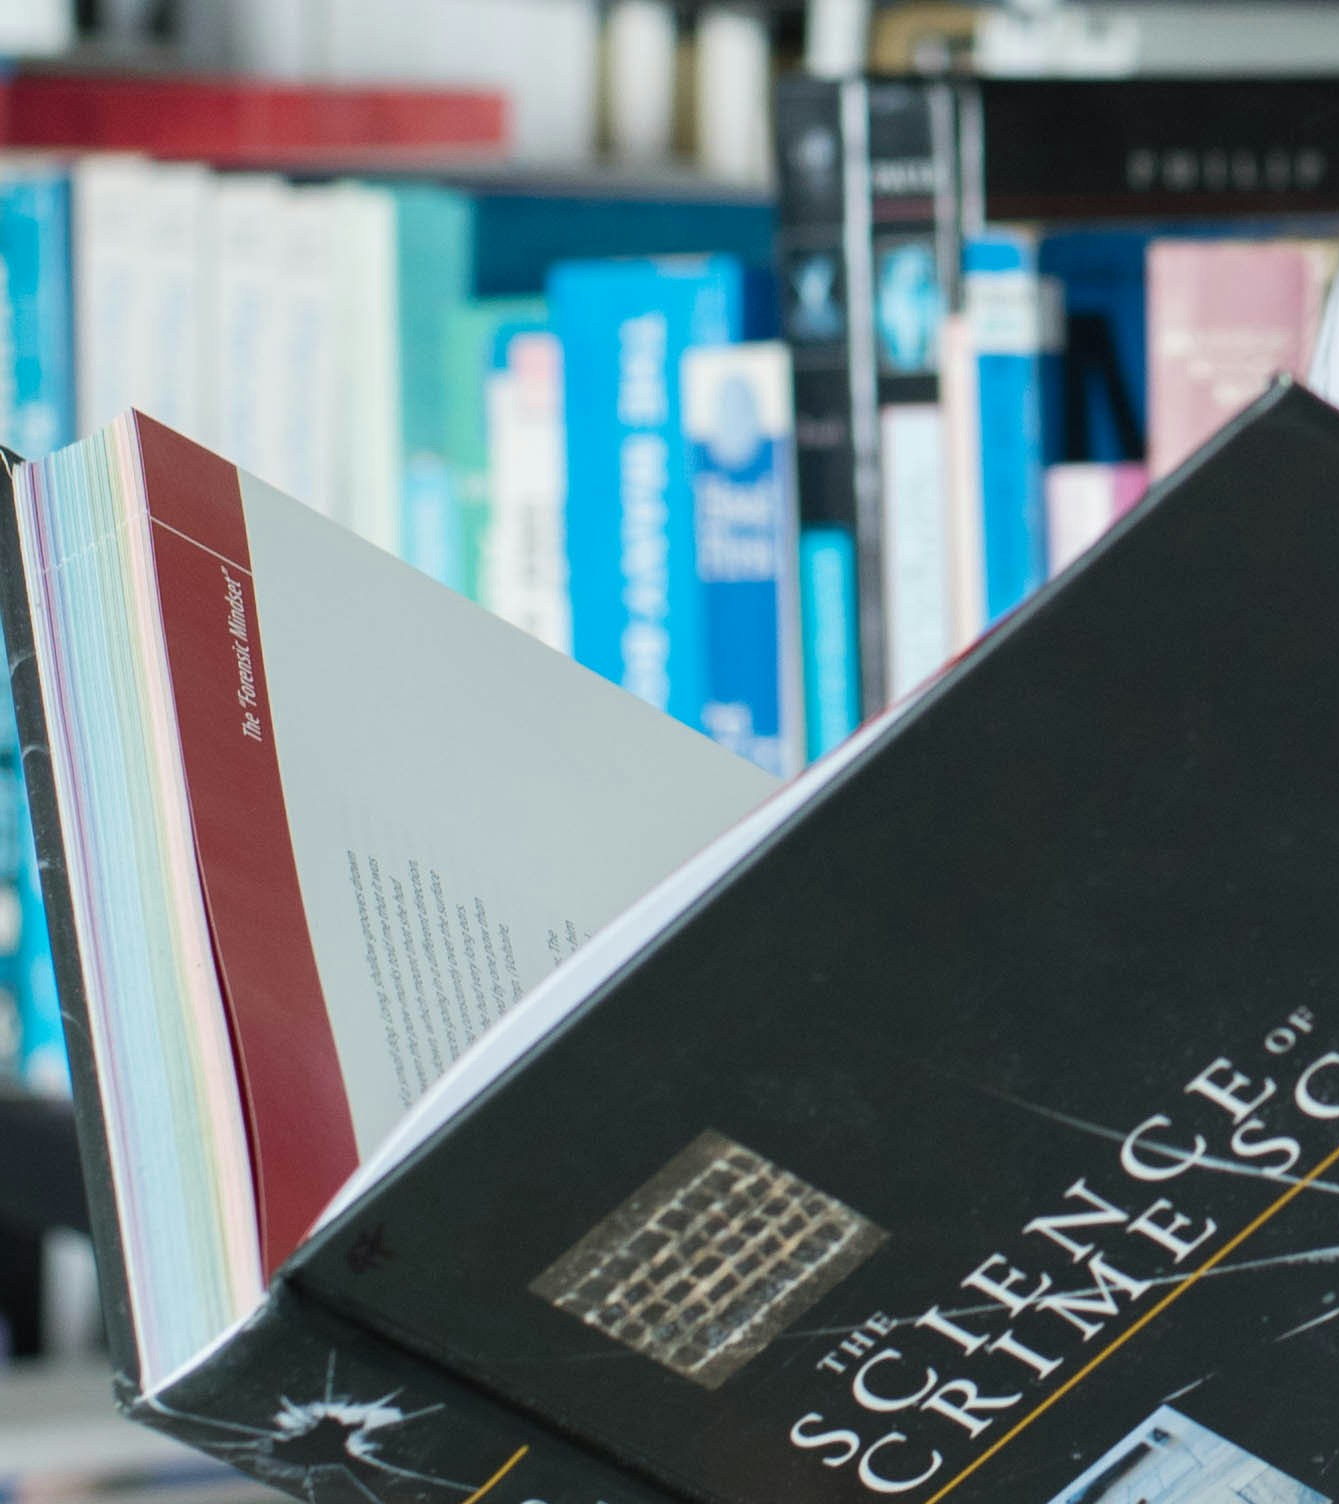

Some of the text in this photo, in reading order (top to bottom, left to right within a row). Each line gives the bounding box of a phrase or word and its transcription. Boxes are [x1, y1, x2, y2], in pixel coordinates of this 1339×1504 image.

[241, 701, 263, 743] The
[788, 1001, 1320, 1467] SCIENCE OF
[816, 1308, 900, 1379] THE
[856, 1198, 1219, 1495] CRIME
